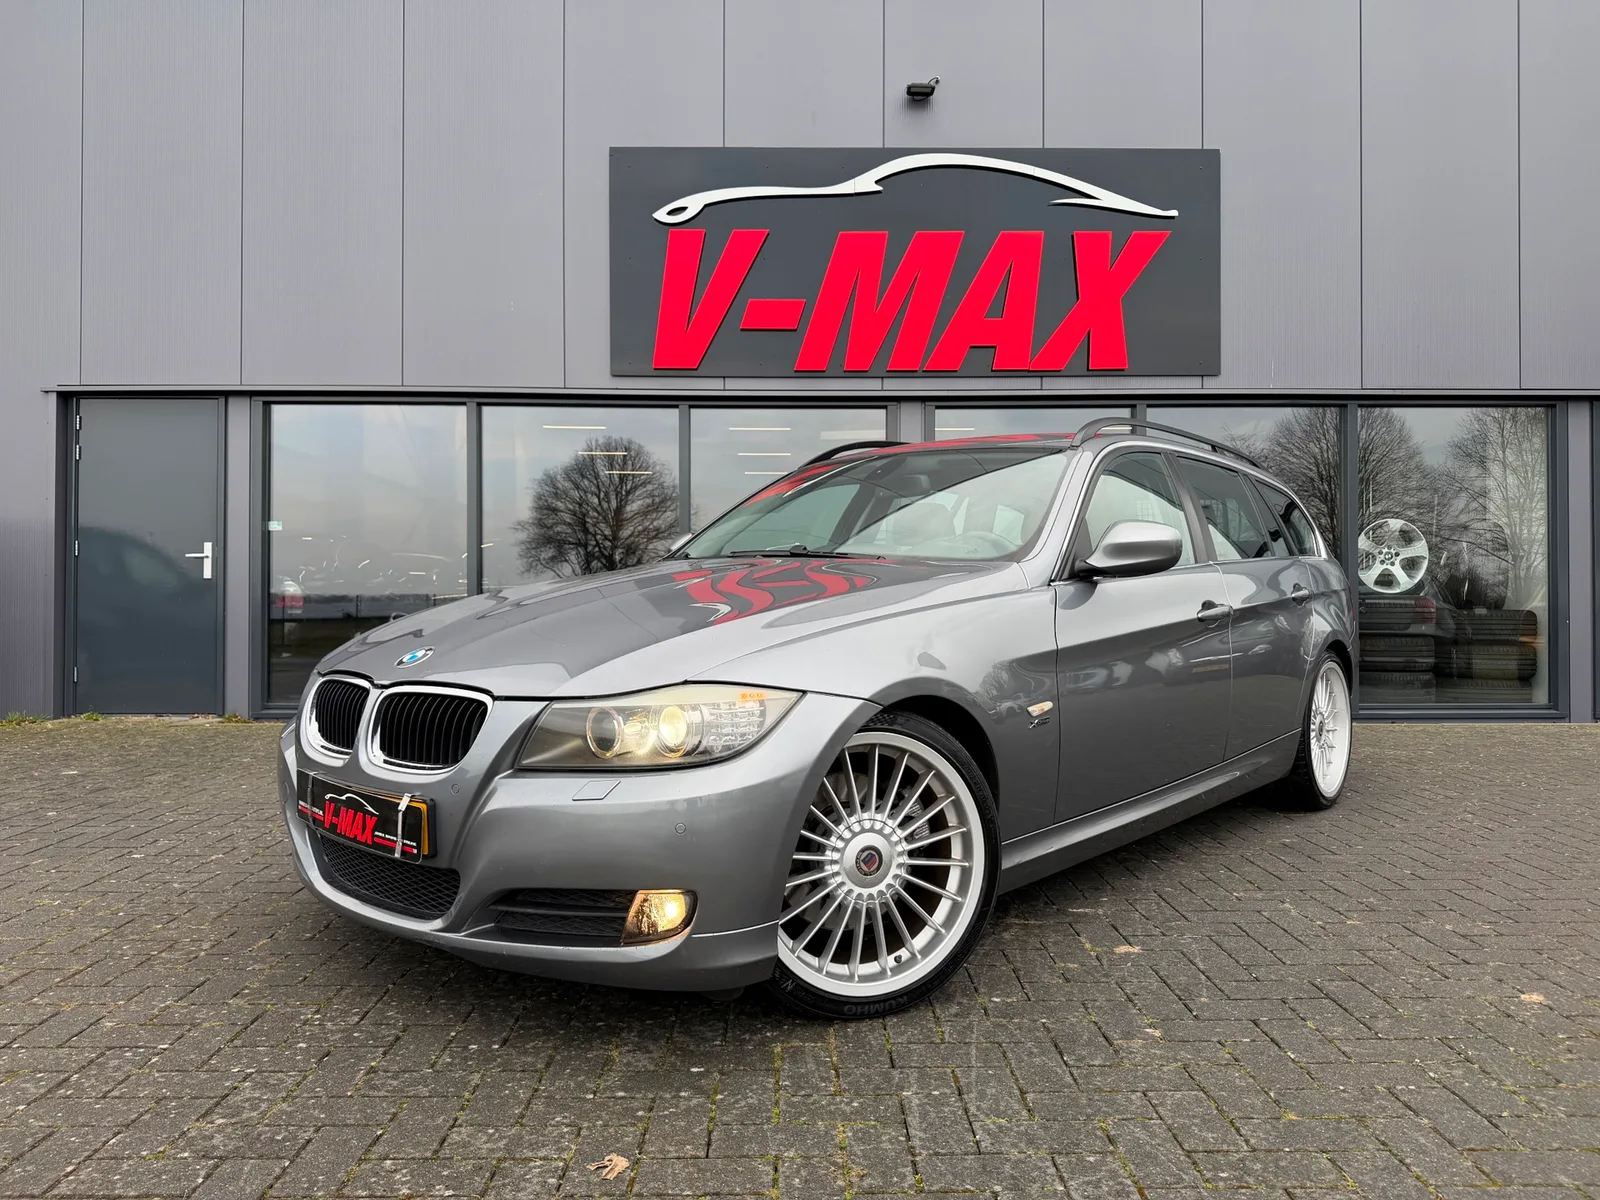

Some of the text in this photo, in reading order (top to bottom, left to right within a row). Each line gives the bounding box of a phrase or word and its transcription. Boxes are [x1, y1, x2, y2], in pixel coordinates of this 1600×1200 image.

[653, 229, 1171, 372] V-MAX
[323, 800, 379, 845] V-MAX
[843, 995, 909, 1016] KUMHO
